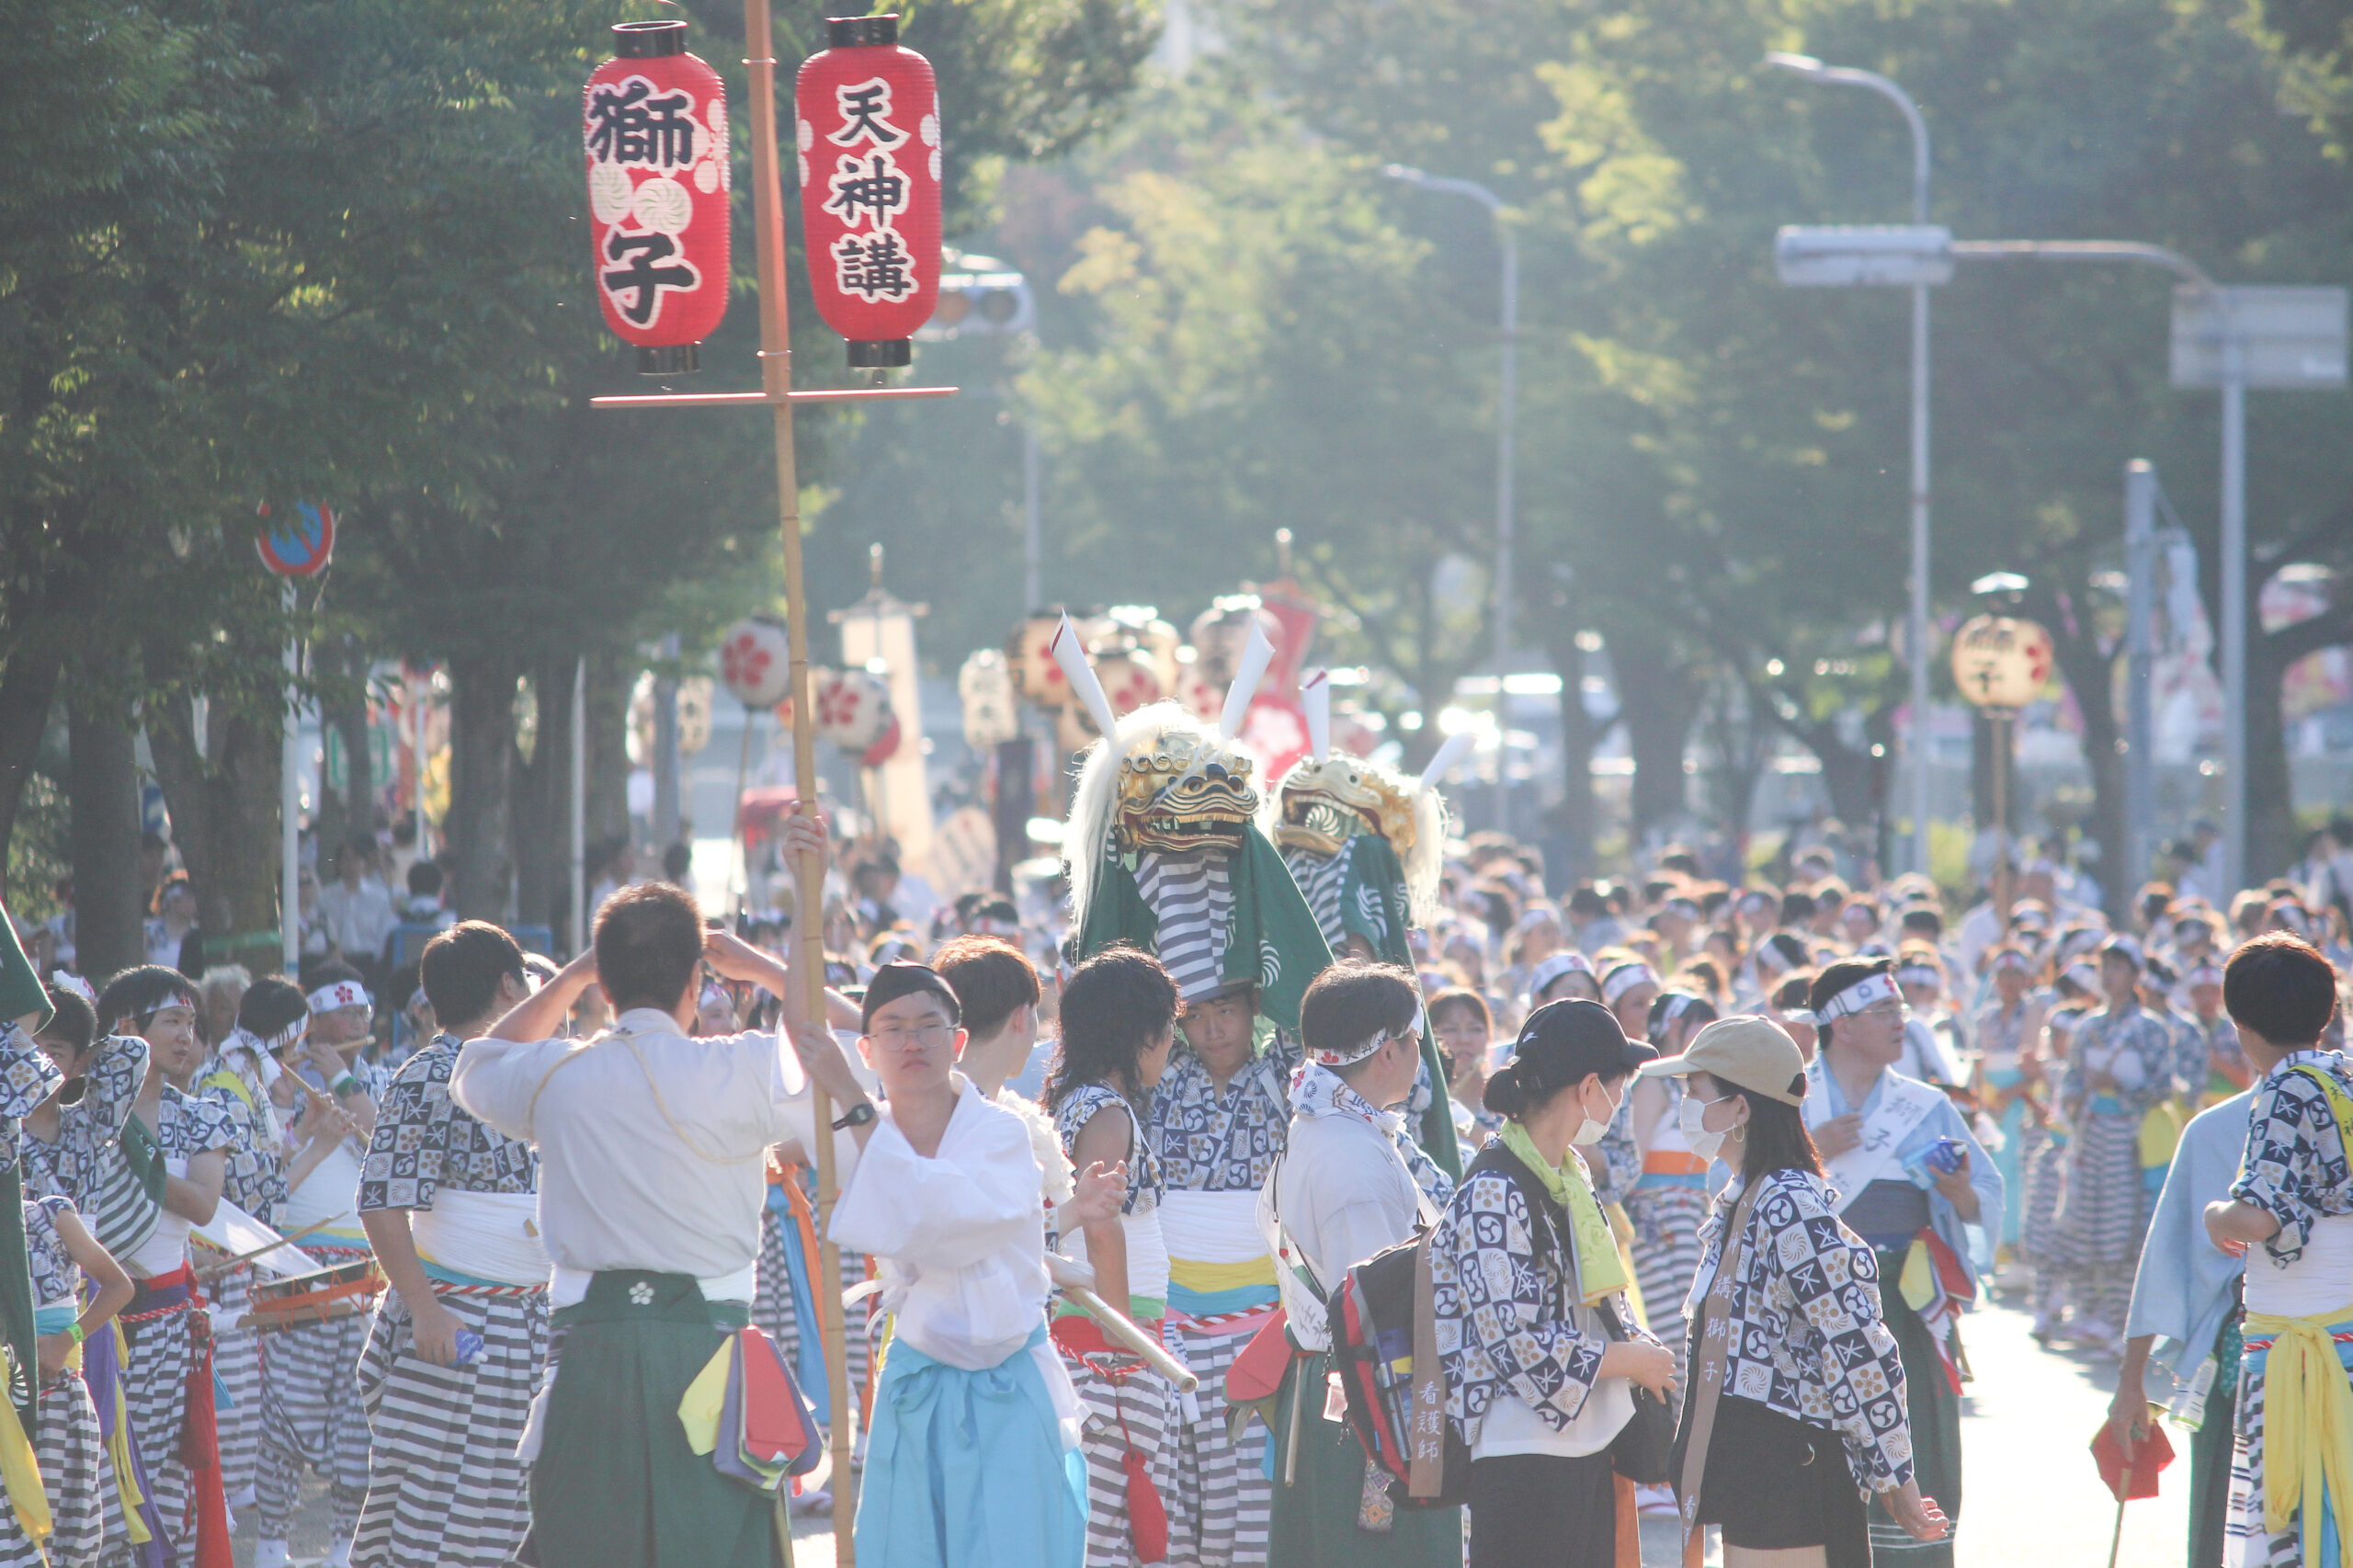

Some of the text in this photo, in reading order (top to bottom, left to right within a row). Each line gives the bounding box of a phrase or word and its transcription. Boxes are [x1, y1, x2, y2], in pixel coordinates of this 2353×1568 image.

[588, 79, 695, 325] 獅子
[829, 83, 913, 299] 天神講
[1865, 1077, 1925, 1153] 獅子
[1703, 1194, 1747, 1382] 神講獅子
[1416, 1381, 1442, 1463] 看護師
